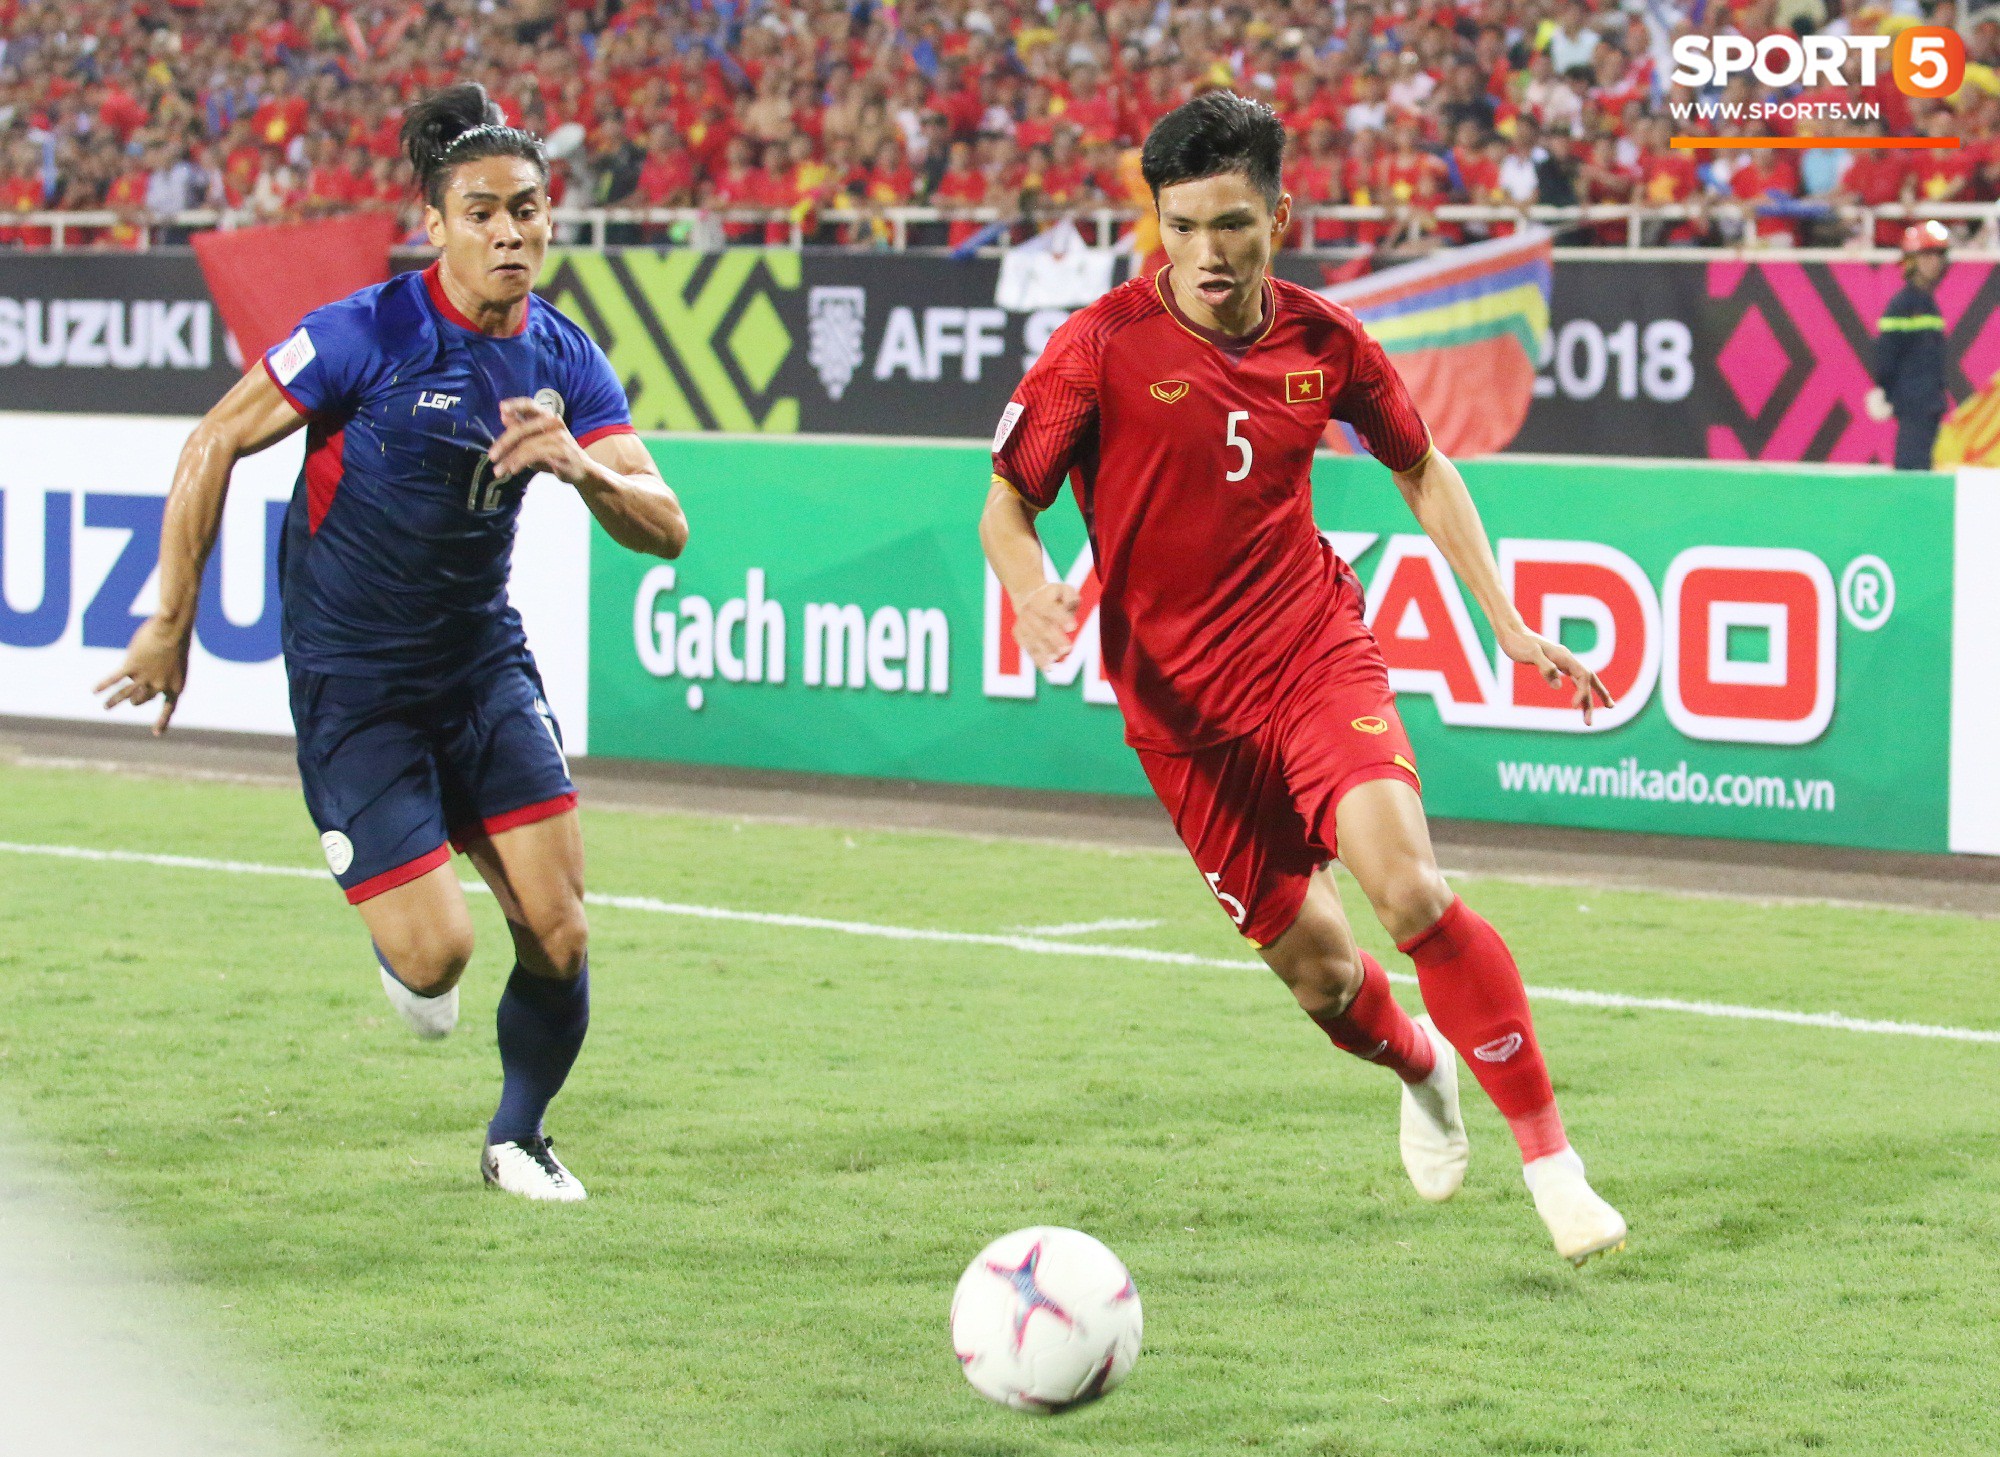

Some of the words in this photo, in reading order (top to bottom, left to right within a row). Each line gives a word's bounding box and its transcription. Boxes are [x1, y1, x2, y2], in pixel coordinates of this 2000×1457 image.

[0, 296, 212, 369] SUZUKI
[873, 306, 1008, 382] AFF
[1225, 410, 1254, 482] 5
[633, 564, 786, 711] Gạch
[804, 602, 950, 693] men
[1498, 757, 1836, 812] www.mikado.com.vn
[1204, 871, 1247, 925] 5
